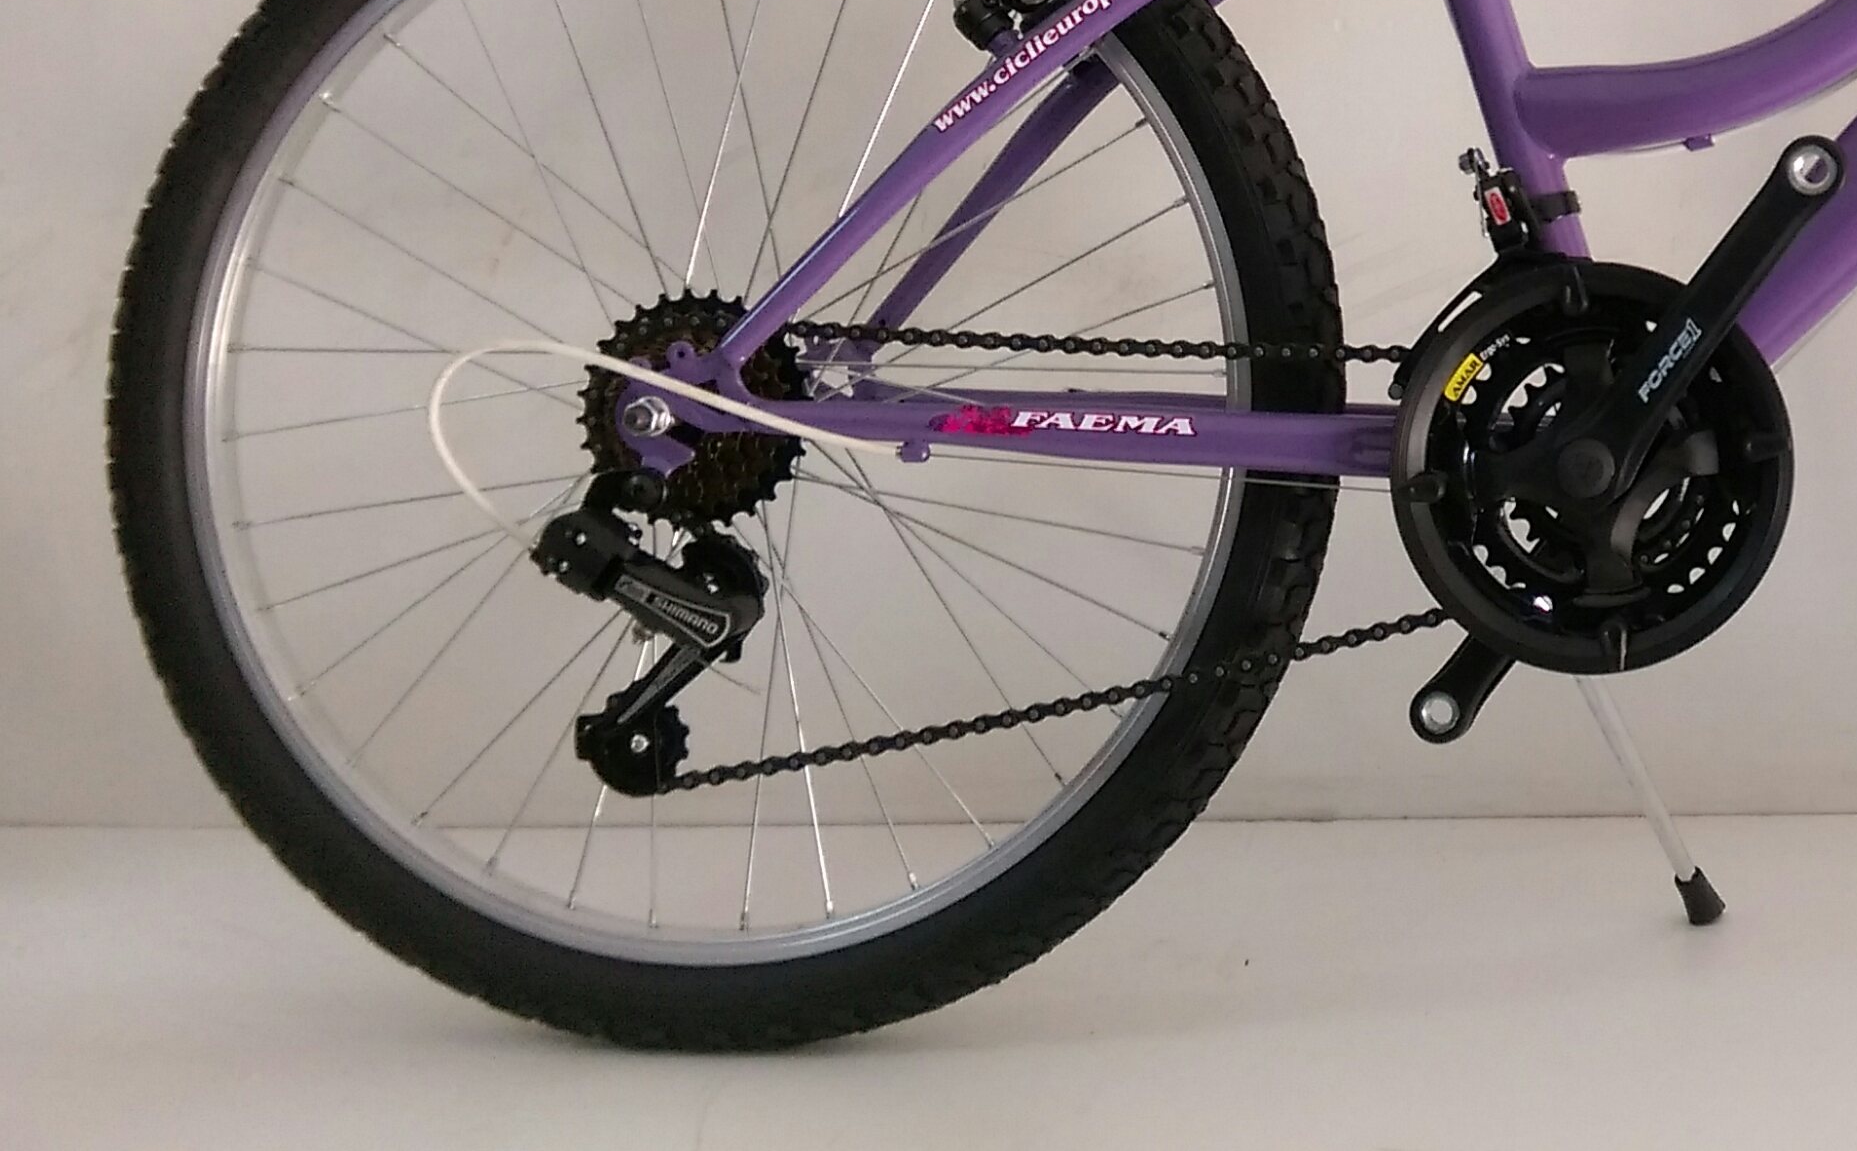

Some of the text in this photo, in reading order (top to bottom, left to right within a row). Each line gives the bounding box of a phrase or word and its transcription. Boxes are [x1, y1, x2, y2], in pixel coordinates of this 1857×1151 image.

[1451, 358, 1482, 398] AMAR
[1638, 317, 1702, 403] FORCE1
[1010, 409, 1197, 437] FAEMA
[653, 597, 719, 635] SHIMANO
